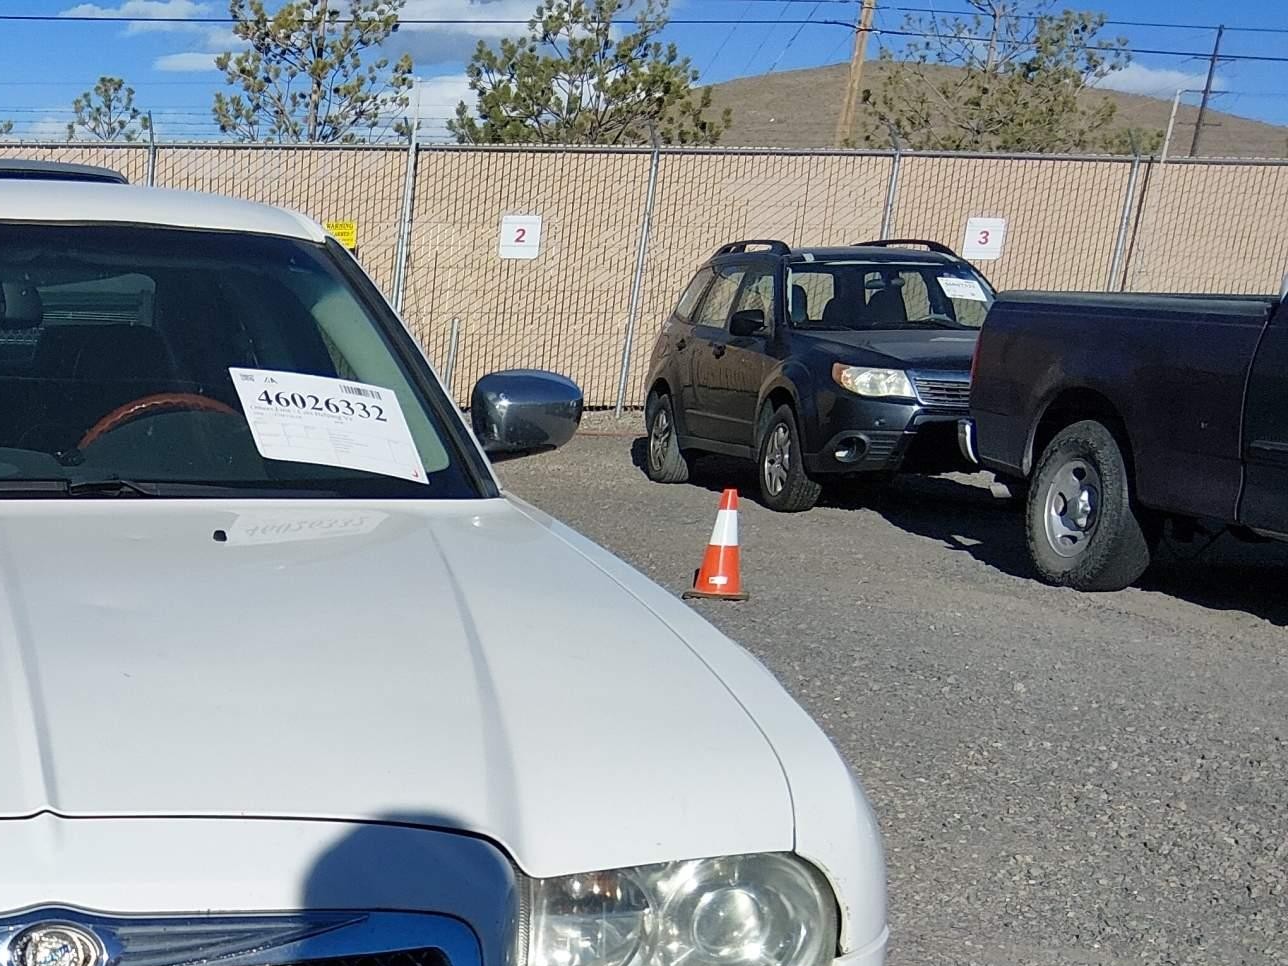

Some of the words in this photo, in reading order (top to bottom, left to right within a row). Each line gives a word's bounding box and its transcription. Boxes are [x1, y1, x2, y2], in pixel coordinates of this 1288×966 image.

[514, 228, 526, 243] 2
[978, 230, 990, 245] 3
[258, 389, 388, 422] 46026332
